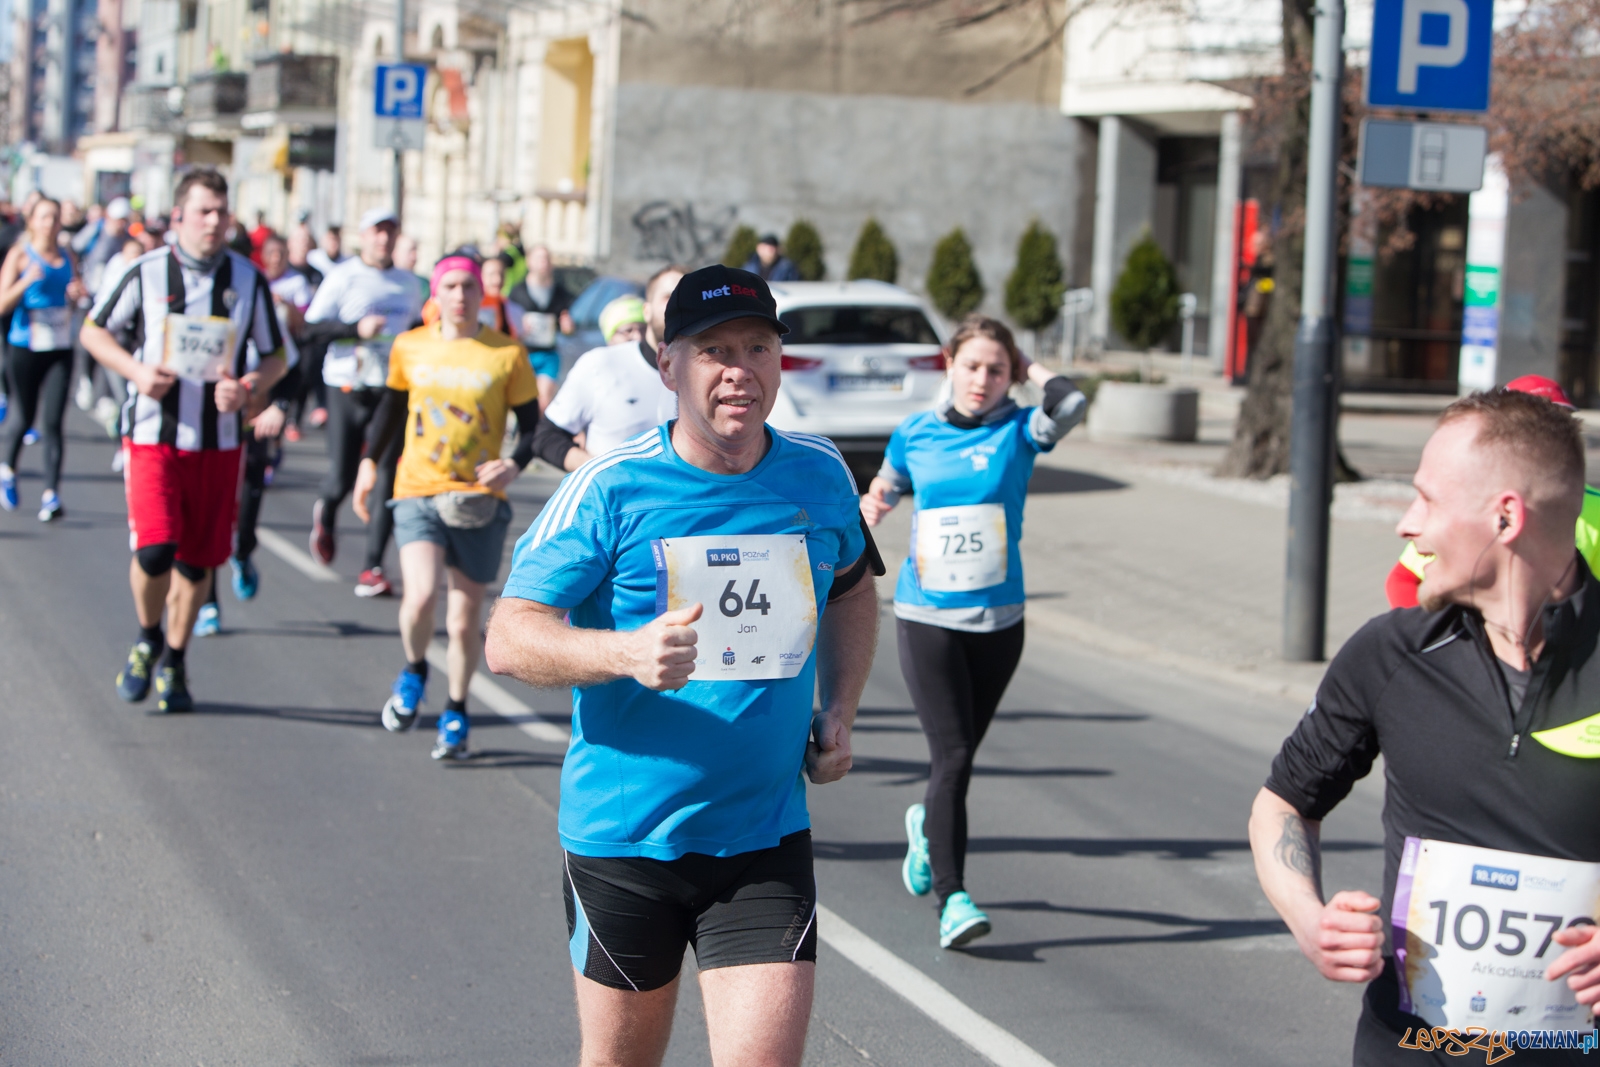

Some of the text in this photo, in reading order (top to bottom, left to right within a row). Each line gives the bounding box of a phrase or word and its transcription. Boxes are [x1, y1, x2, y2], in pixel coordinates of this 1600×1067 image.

[1397, 0, 1469, 94] P
[383, 70, 418, 111] P
[702, 284, 758, 300] NetBet
[939, 531, 984, 556] 725
[719, 579, 771, 618] 64
[737, 623, 757, 634] Jan
[1429, 900, 1597, 958] 1057
[1471, 961, 1545, 980] Arkadiusz
